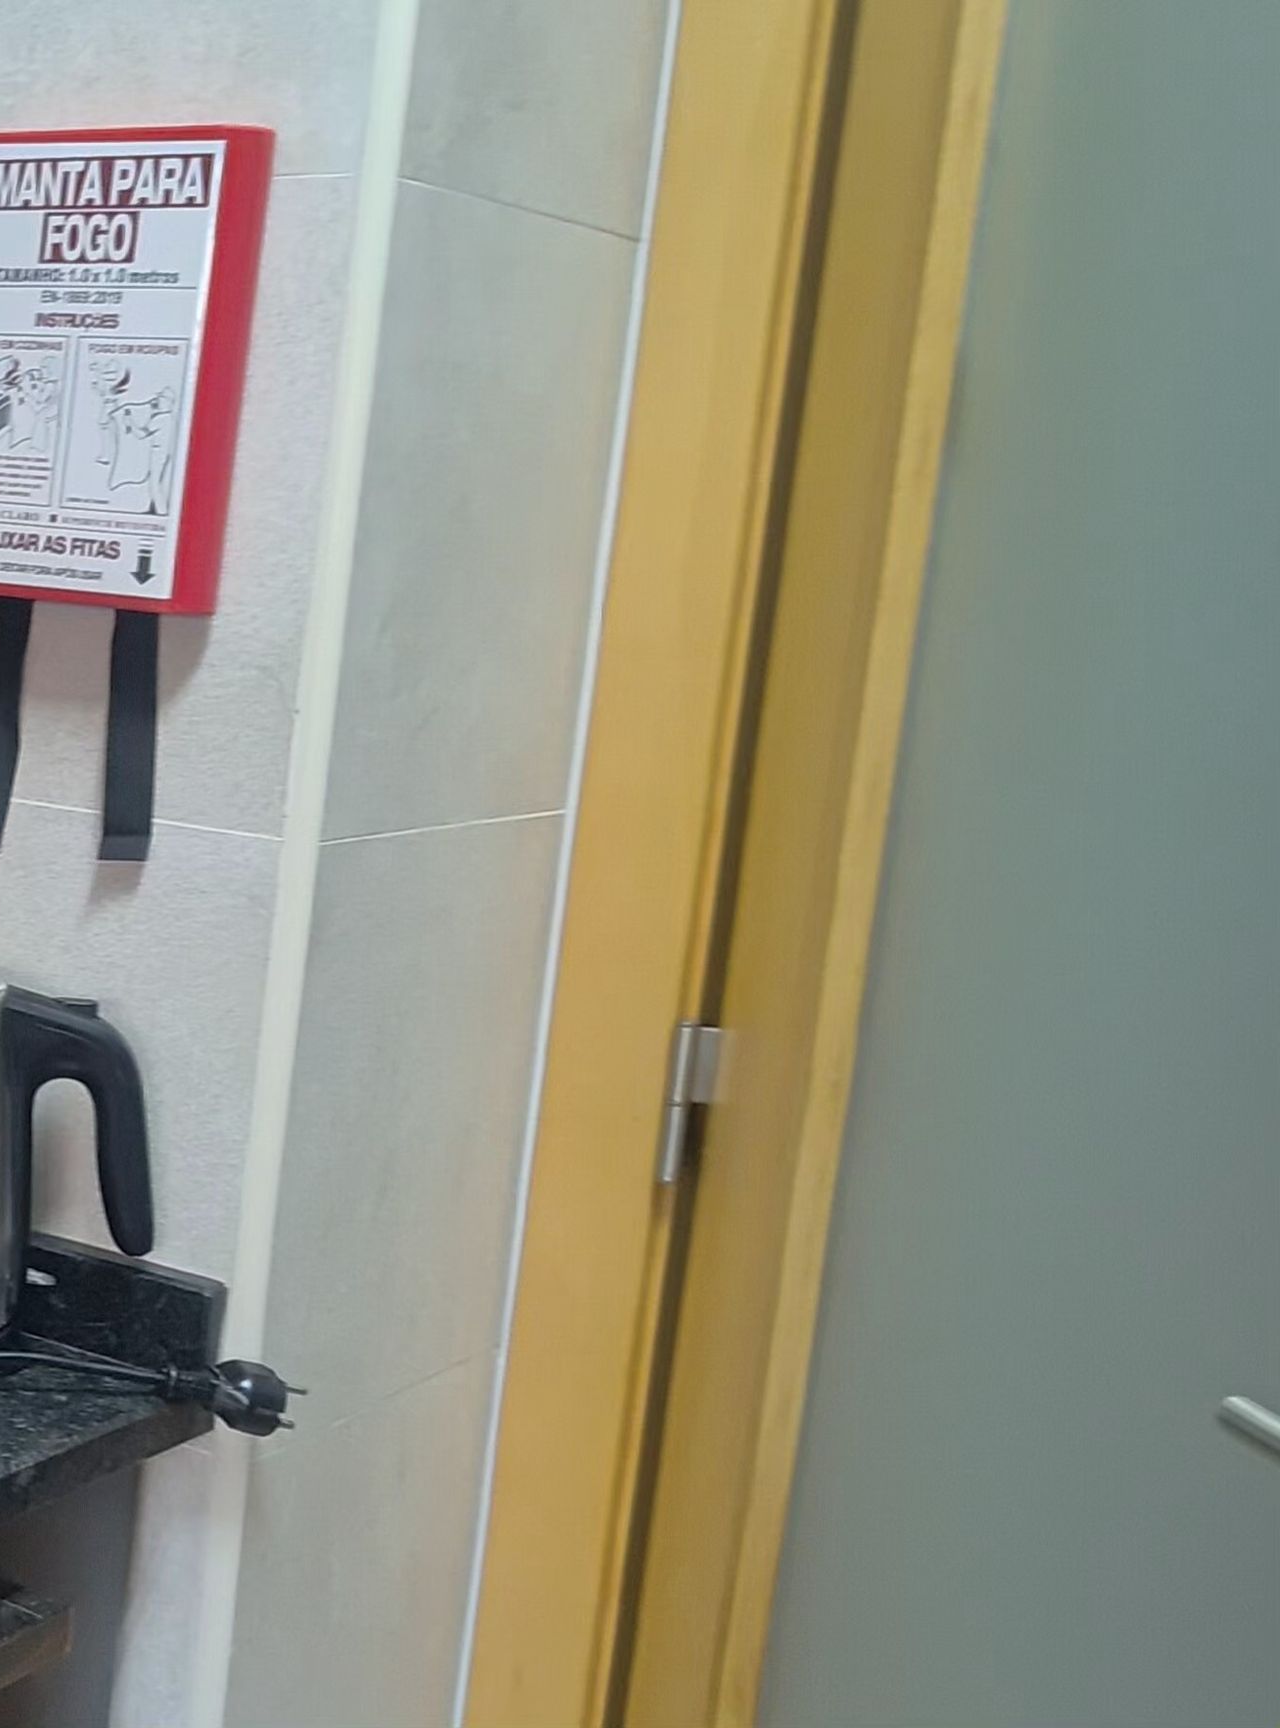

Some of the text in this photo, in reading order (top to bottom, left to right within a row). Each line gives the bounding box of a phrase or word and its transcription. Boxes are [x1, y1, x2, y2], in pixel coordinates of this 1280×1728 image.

[108, 157, 205, 206] PARA
[44, 213, 133, 262] FOGO
[40, 535, 66, 555] AS
[69, 537, 121, 560] FITAS
